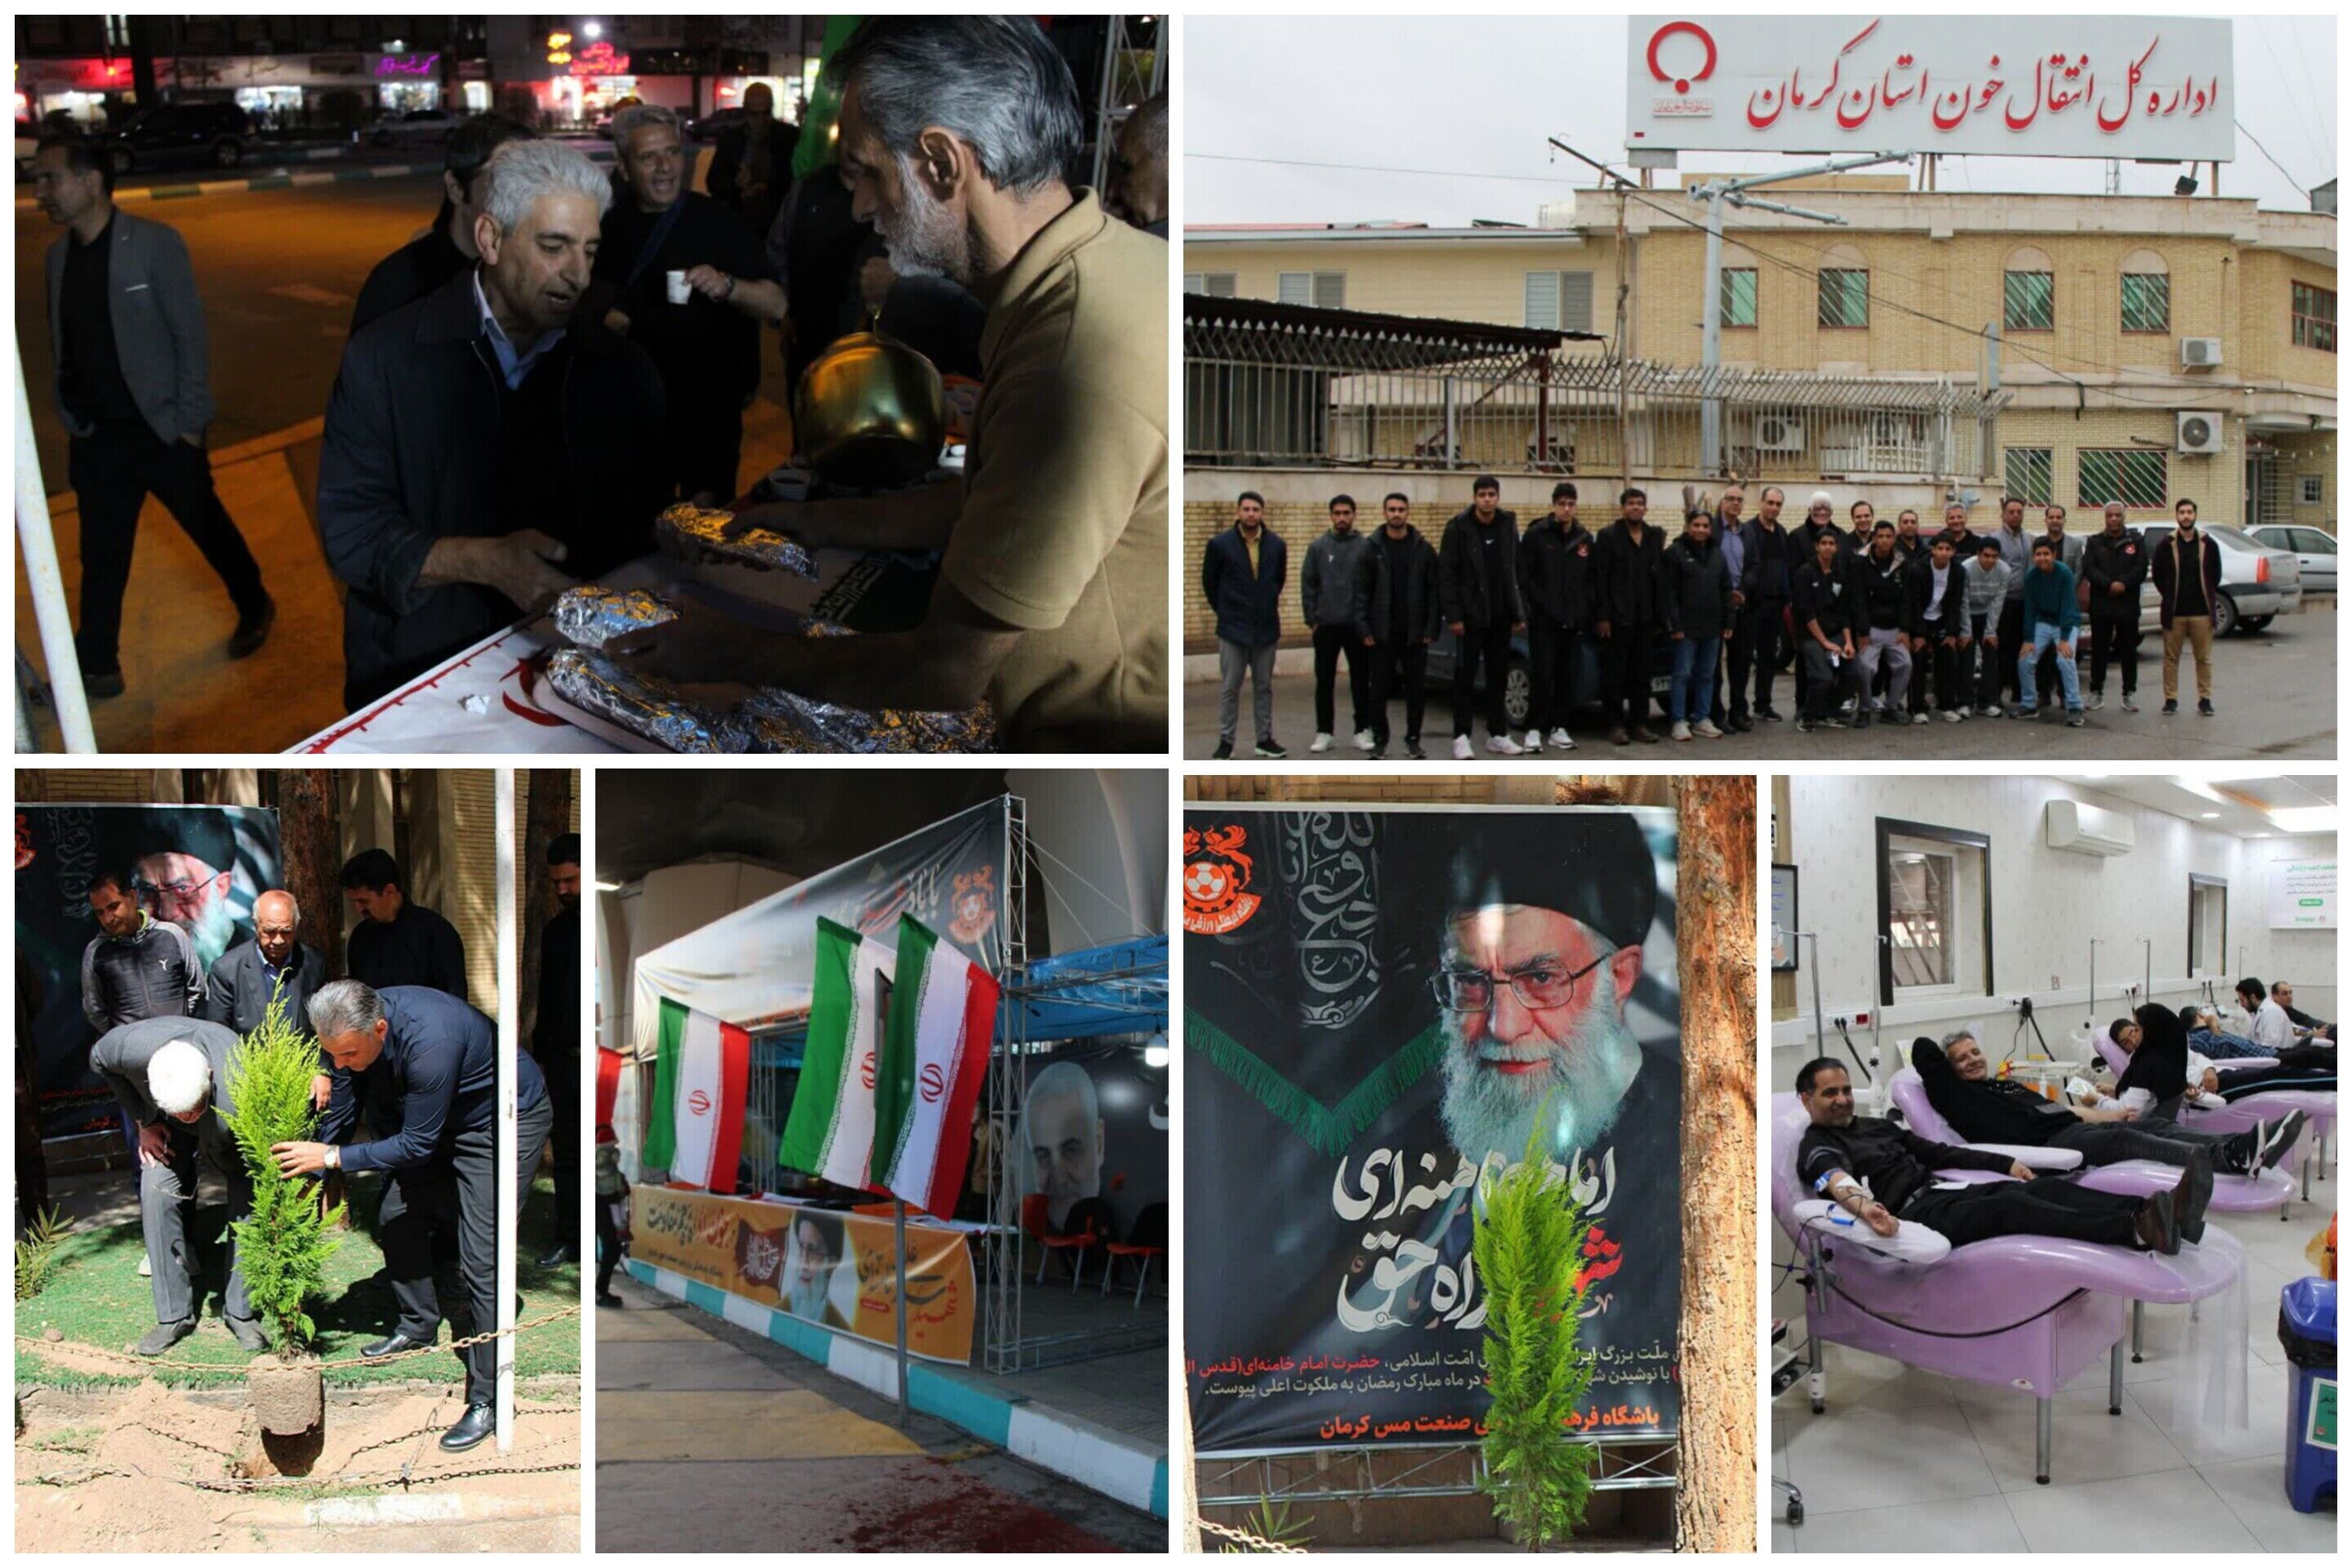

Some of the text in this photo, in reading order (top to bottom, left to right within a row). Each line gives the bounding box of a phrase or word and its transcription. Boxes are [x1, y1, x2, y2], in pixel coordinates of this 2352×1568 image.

[1747, 18, 2216, 132] اداره کل انتقال خون استان کرمان
[1337, 1229, 1439, 1333] حق
[1298, 1354, 1329, 1375] امام
[1332, 1354, 1380, 1374] حضرت
[1600, 1345, 1633, 1365] بزرگ
[1356, 1374, 1401, 1392] رمضان
[1402, 1373, 1442, 1392] مبارک
[1444, 1372, 1464, 1387] ماه
[1468, 1374, 1481, 1390] در
[1608, 1366, 1658, 1386] نوشیدن
[1660, 1365, 1671, 1383] با
[1258, 1379, 1290, 1396] اعلی
[1293, 1377, 1337, 1396] ملکوت
[1340, 1382, 1355, 1394] به
[1415, 1415, 1471, 1432] صنعت
[1602, 1405, 1660, 1428] باشگاه
[1320, 1414, 1371, 1440] کرمان
[1374, 1419, 1411, 1438] مس
